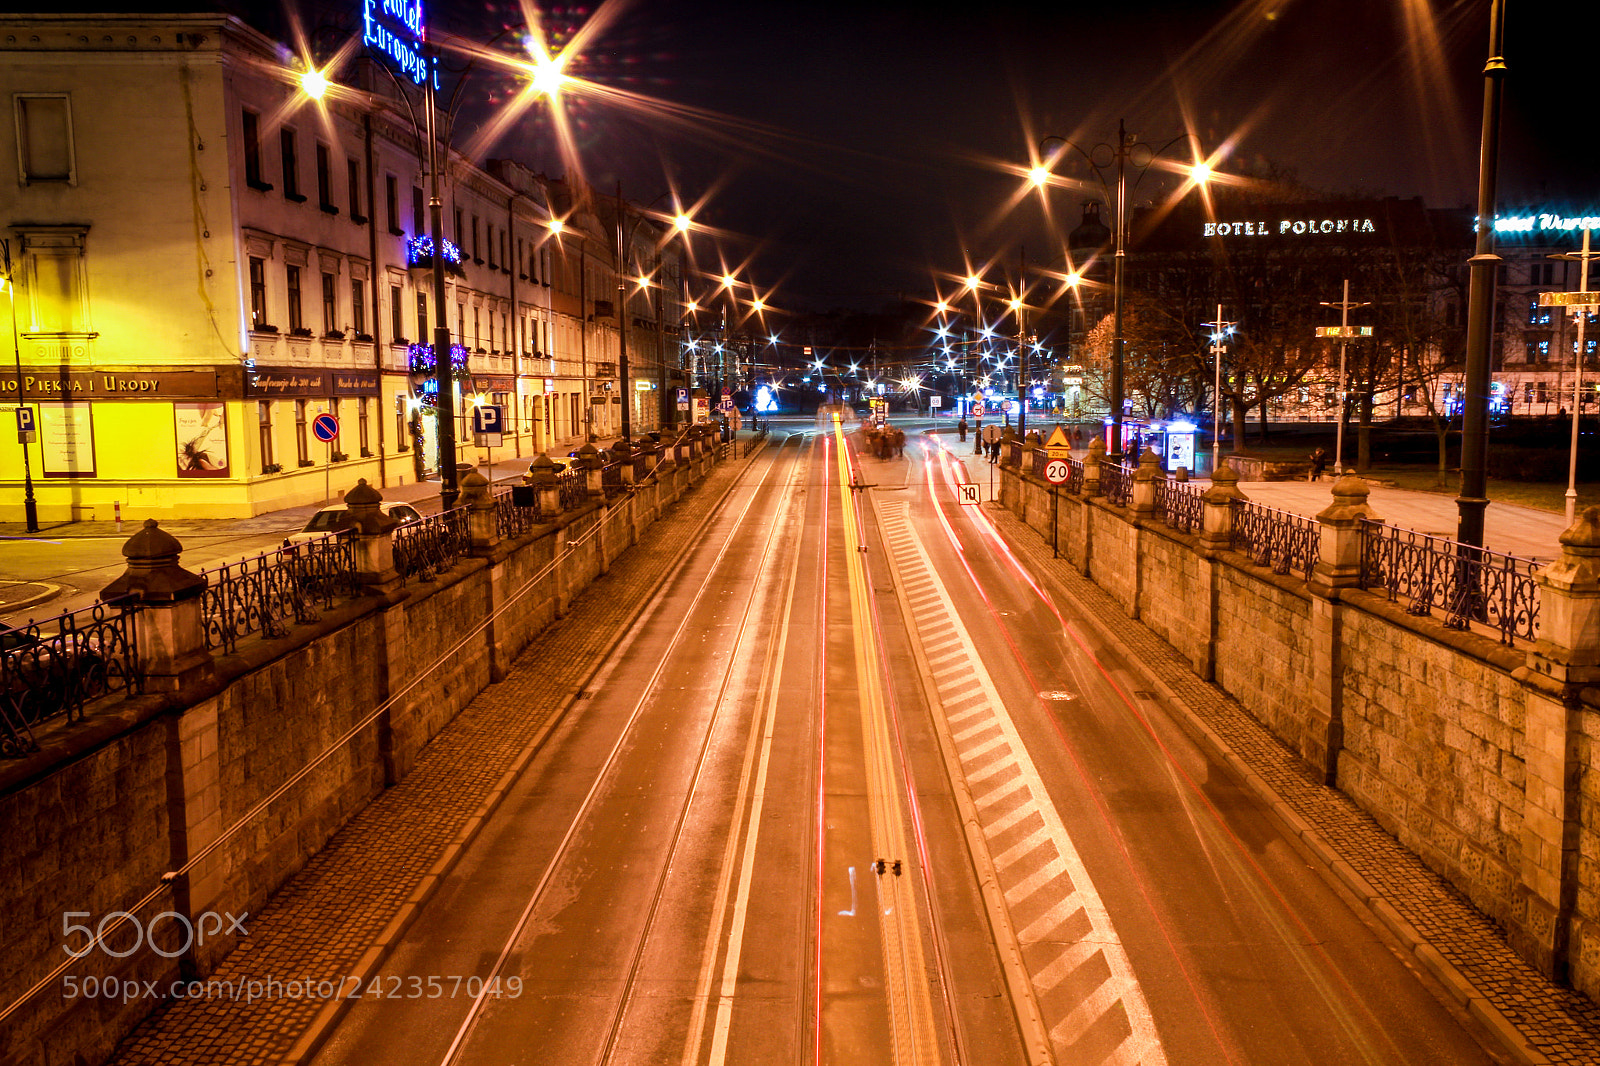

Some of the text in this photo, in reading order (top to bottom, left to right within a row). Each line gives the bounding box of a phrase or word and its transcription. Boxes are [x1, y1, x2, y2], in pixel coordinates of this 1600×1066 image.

[364, 0, 440, 90] Europejsi
[1203, 219, 1376, 237] HOTEL POLONIA
[20, 409, 31, 429] P
[480, 408, 496, 431] P
[1049, 465, 1067, 478] 20
[964, 486, 976, 501] 10
